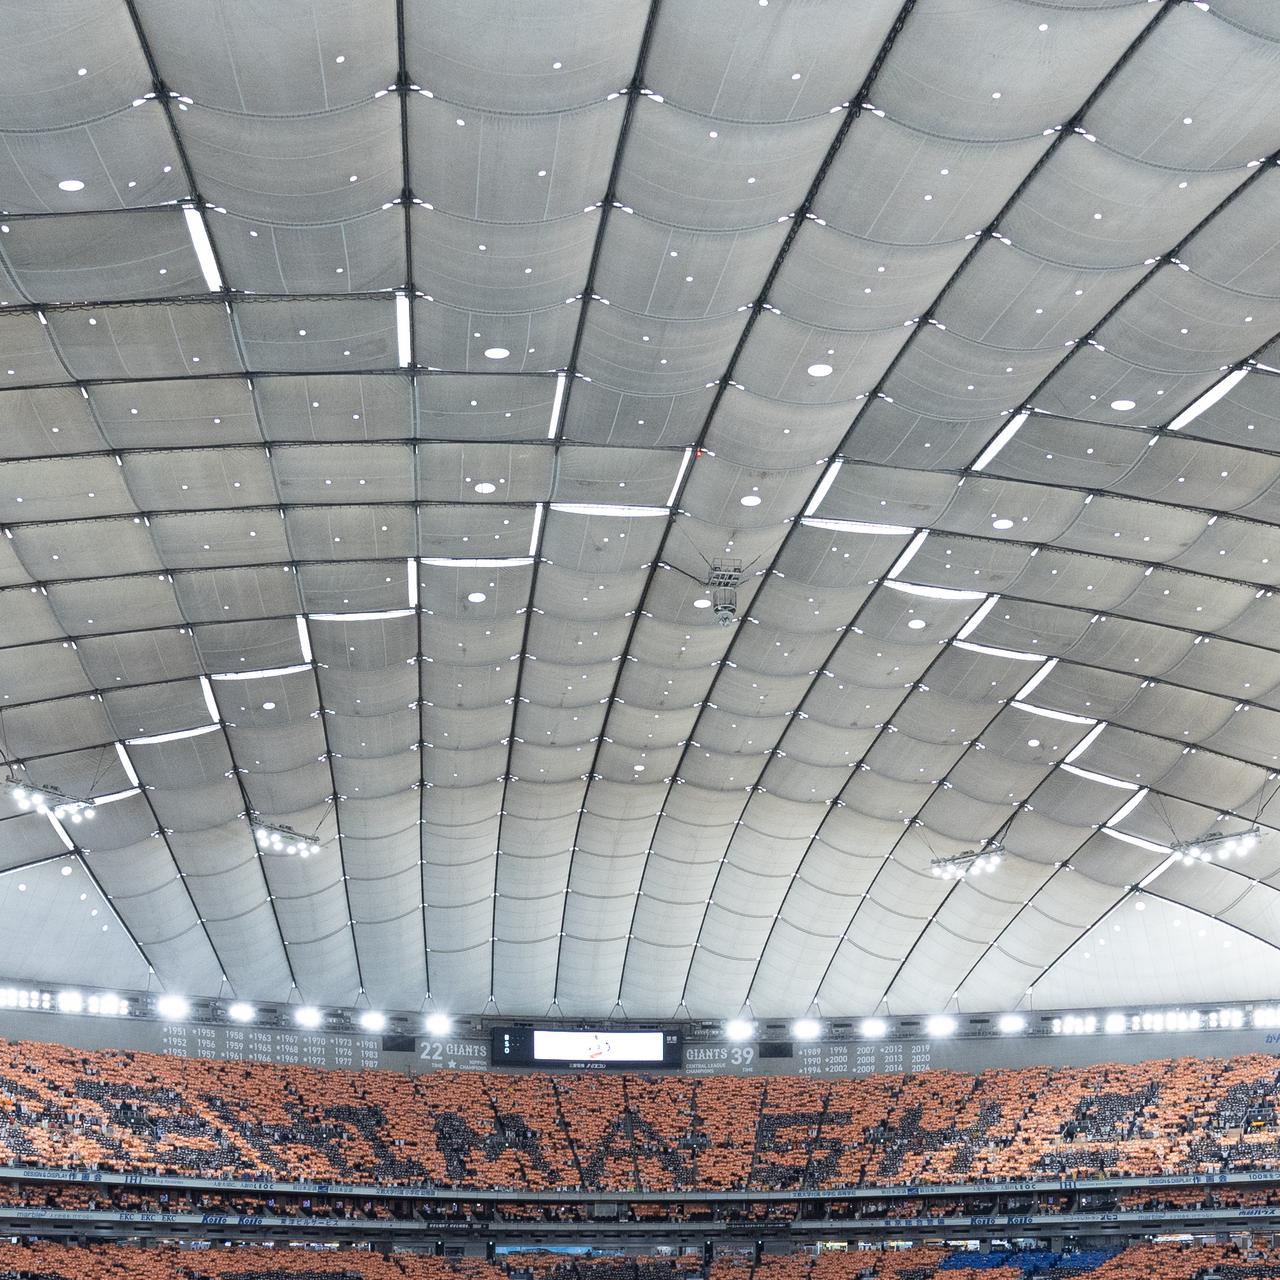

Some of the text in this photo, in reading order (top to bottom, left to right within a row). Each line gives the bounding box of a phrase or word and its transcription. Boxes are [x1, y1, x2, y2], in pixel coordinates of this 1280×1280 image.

[168, 1028, 378, 1049] 1951 1955 1958 1963 1967 1970 1973 1981
[168, 1038, 378, 1058] 1952 1956 1959 1965 1968 1971 1976 1983
[420, 1042, 487, 1060] 22 GIANTS
[686, 1047, 754, 1065] GIANTS 39
[885, 1045, 902, 1053] 2012
[168, 1049, 378, 1068] 1953 1957 1961 1966 1969 1972 1977 1987
[125, 1175, 143, 1185] IHI
